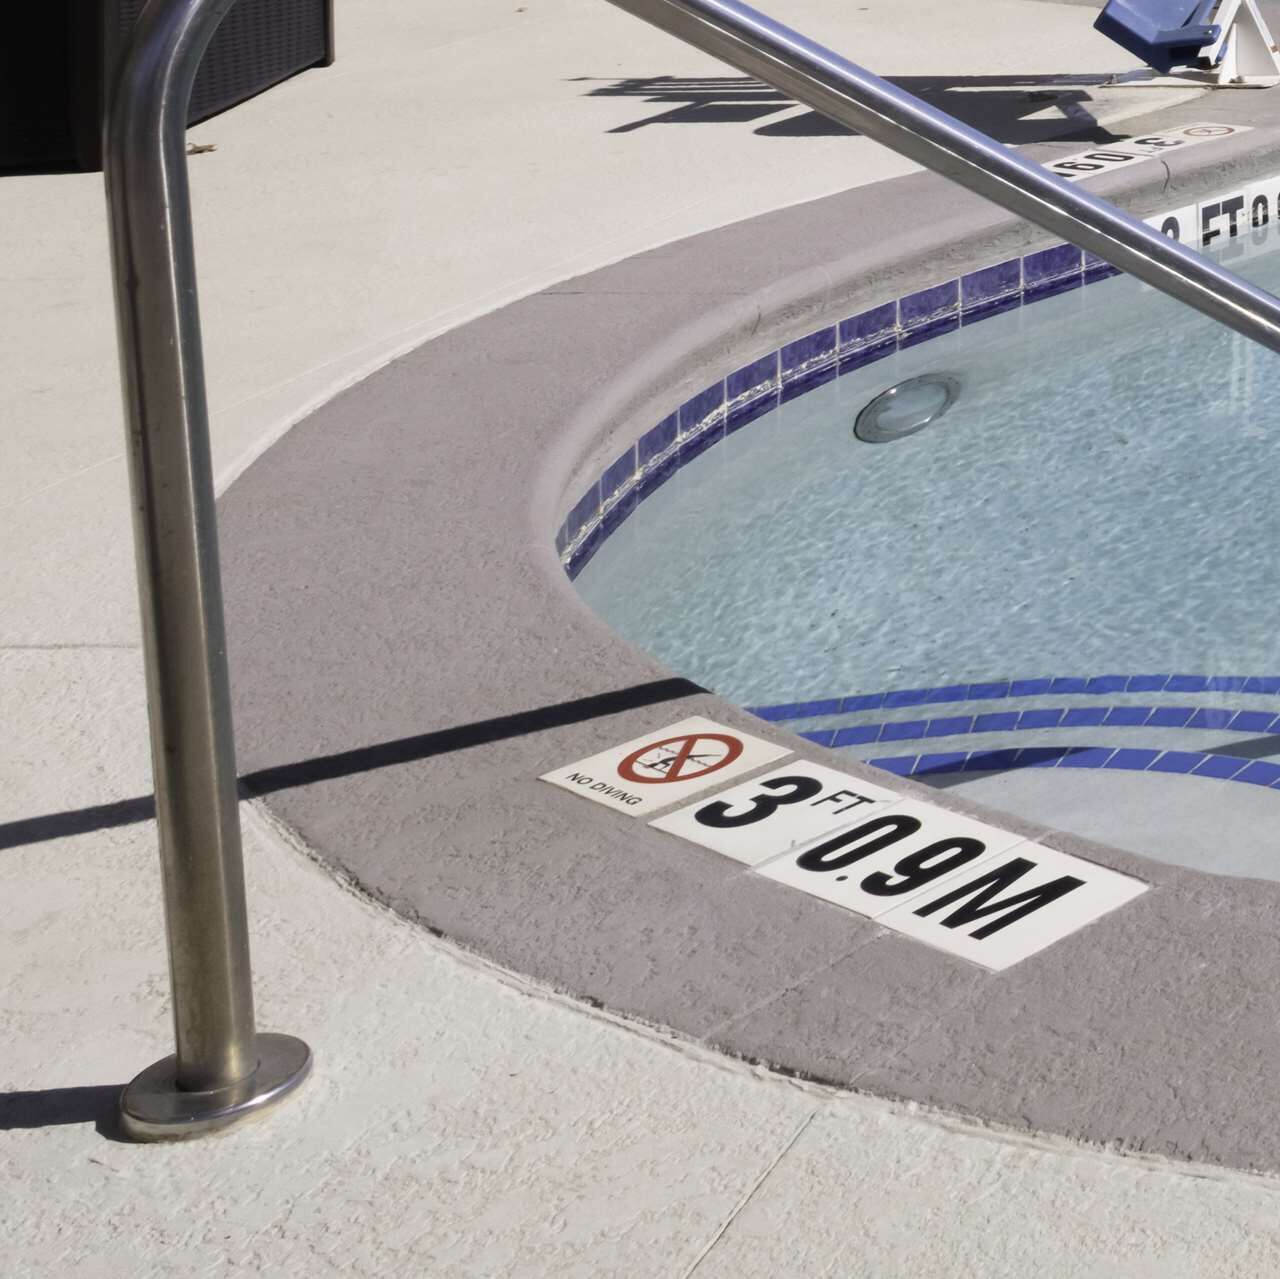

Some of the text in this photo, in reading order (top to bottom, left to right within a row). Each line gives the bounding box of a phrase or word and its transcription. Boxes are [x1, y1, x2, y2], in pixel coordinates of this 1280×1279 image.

[1202, 195, 1244, 246] FT
[565, 772, 643, 805] NO DIVING
[693, 775, 823, 829] 3
[811, 789, 877, 816] FT
